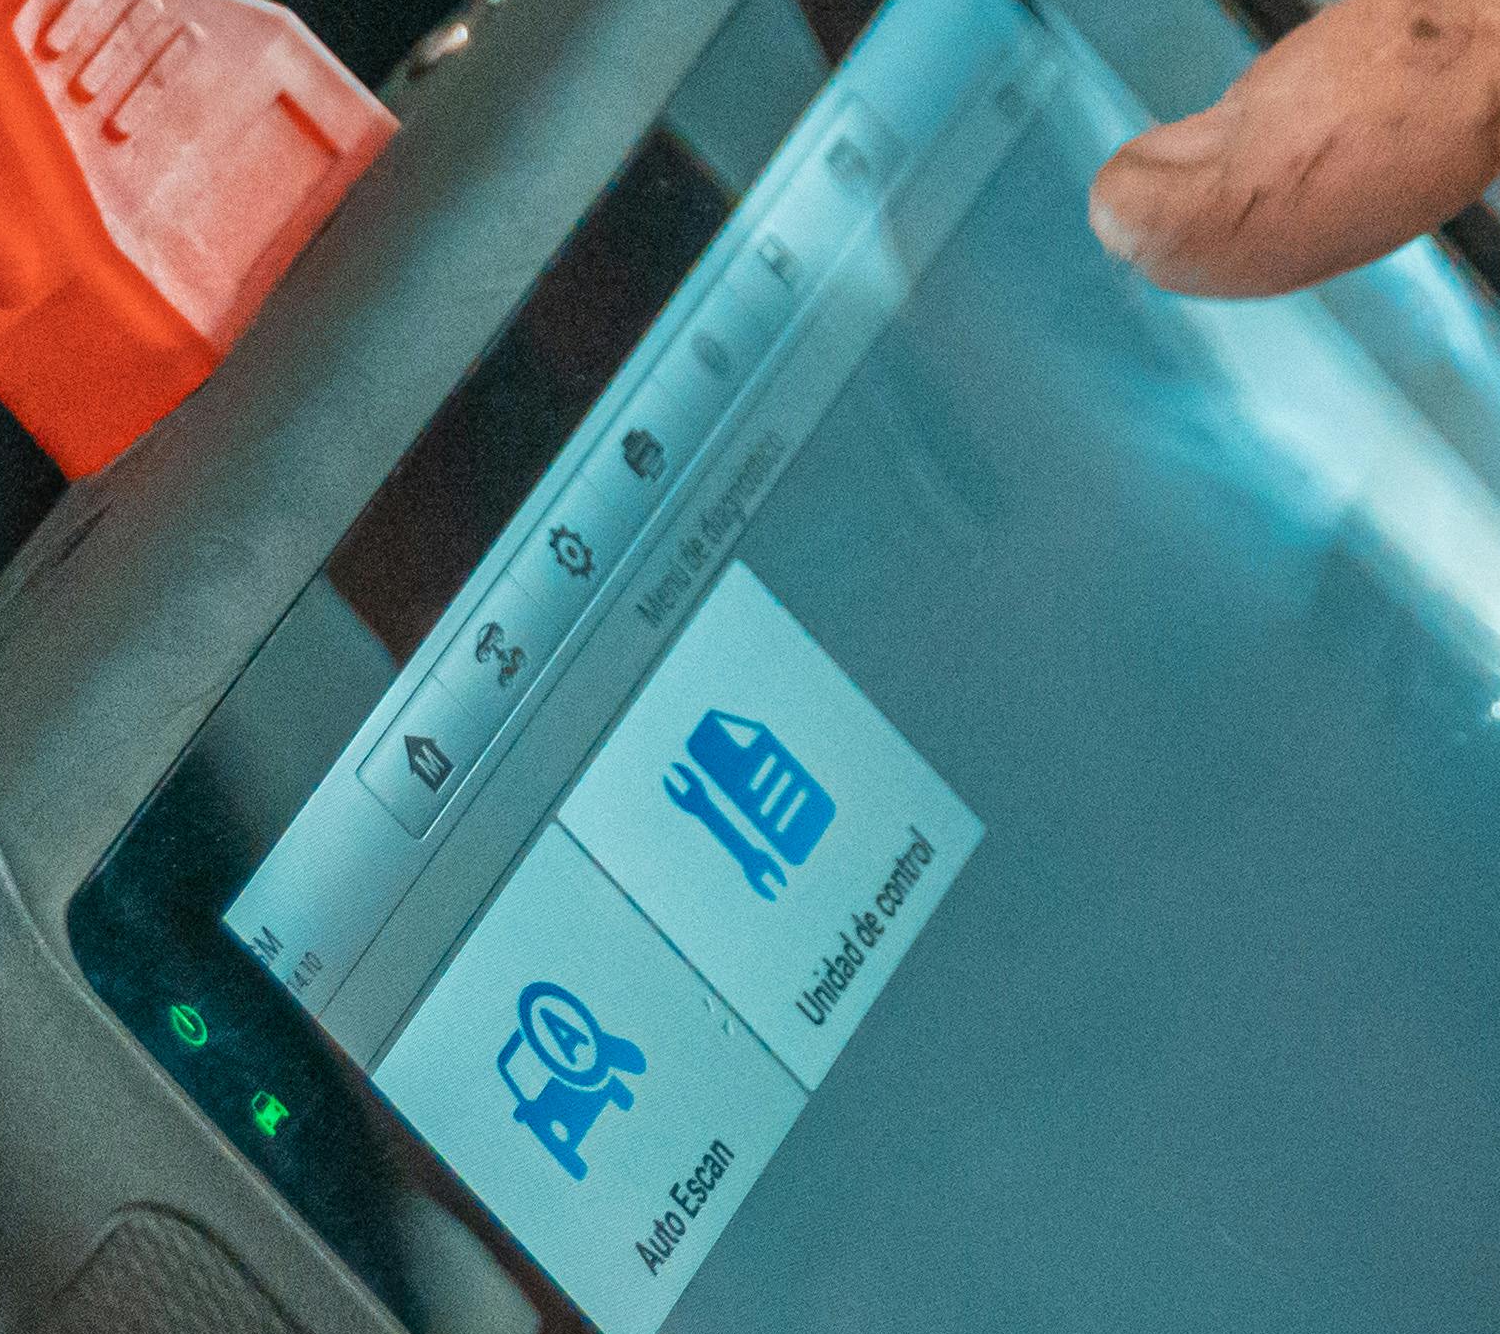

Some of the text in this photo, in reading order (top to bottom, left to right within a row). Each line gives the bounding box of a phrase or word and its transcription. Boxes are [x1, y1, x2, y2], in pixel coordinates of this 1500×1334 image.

[795, 825, 936, 1027] Unidad de control
[634, 1139, 735, 1278] Auto Escan
